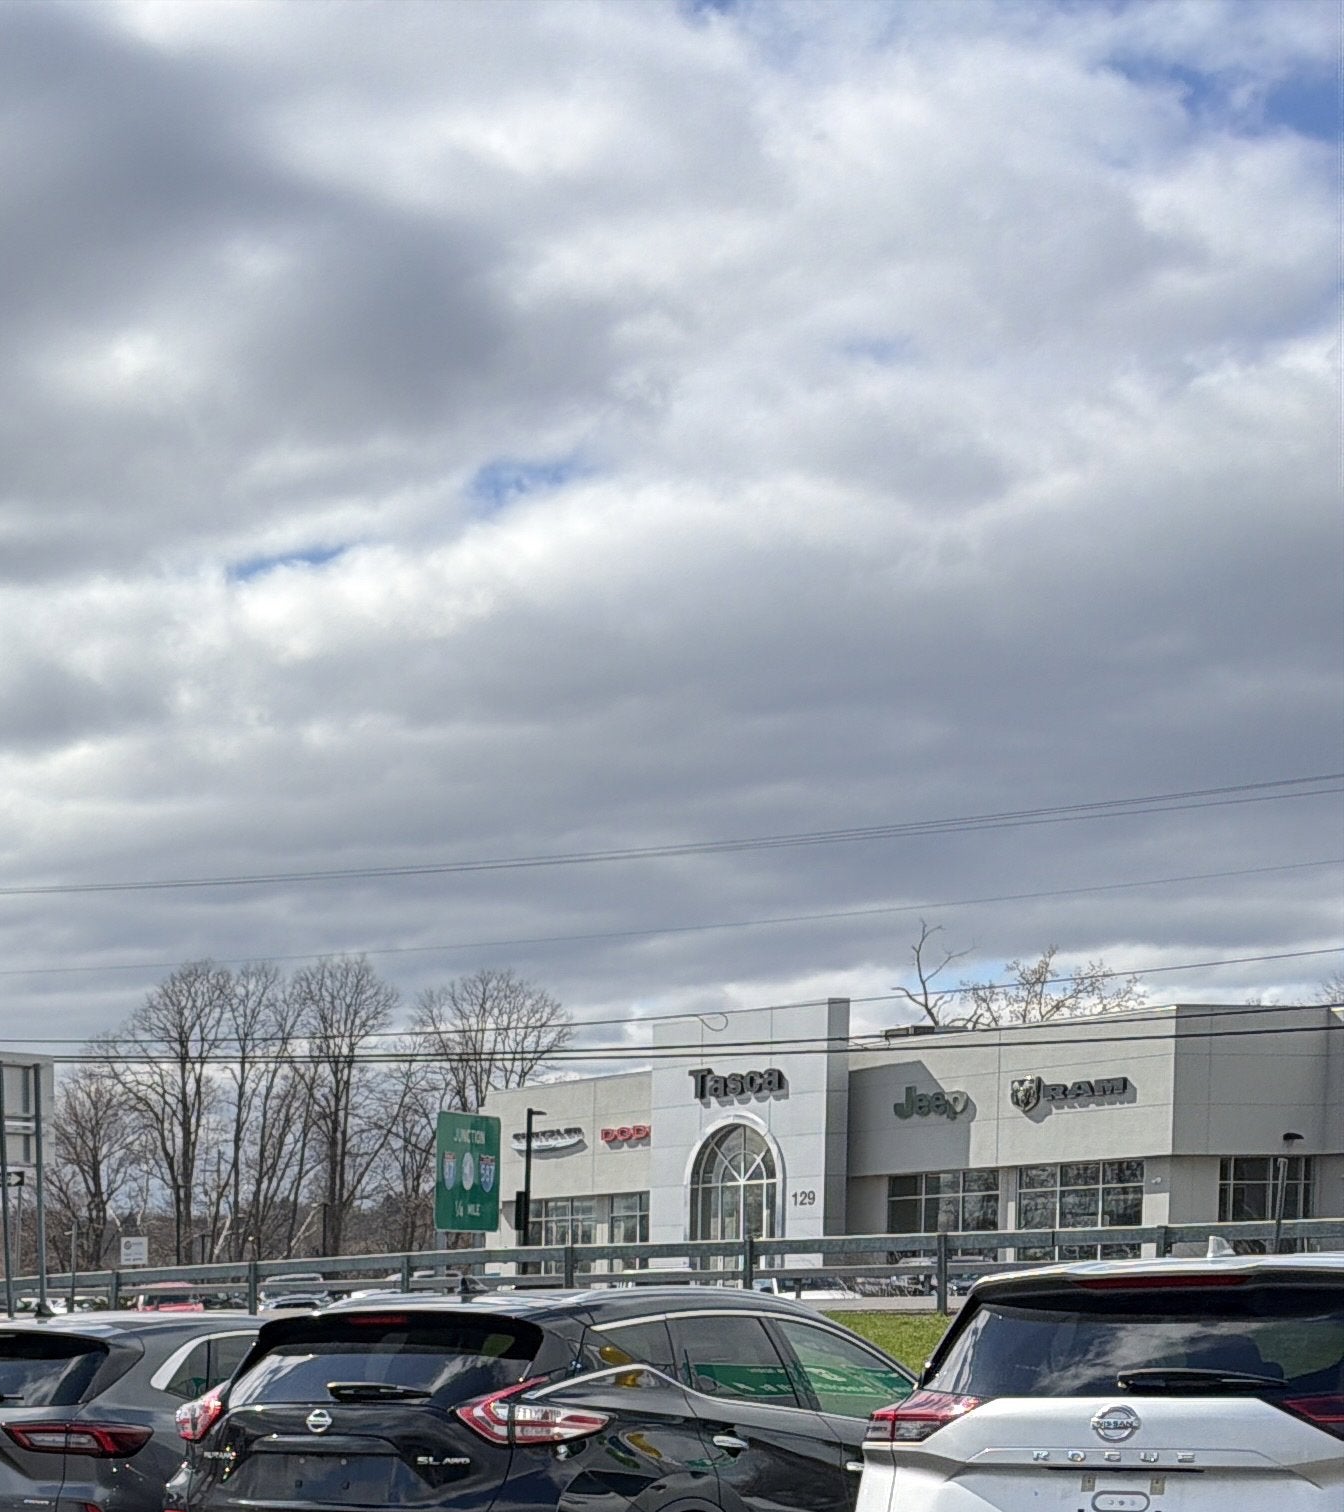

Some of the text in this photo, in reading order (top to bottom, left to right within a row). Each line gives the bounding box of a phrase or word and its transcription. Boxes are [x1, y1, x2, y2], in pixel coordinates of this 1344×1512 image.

[689, 1068, 786, 1101] Tasca
[1042, 1077, 1129, 1101] RAM
[893, 1086, 968, 1121] Jeep
[791, 1191, 816, 1207] 129
[1095, 1419, 1135, 1429] NISSAN
[416, 1455, 471, 1466] SL AWD
[1032, 1449, 1196, 1464] ROGUE
